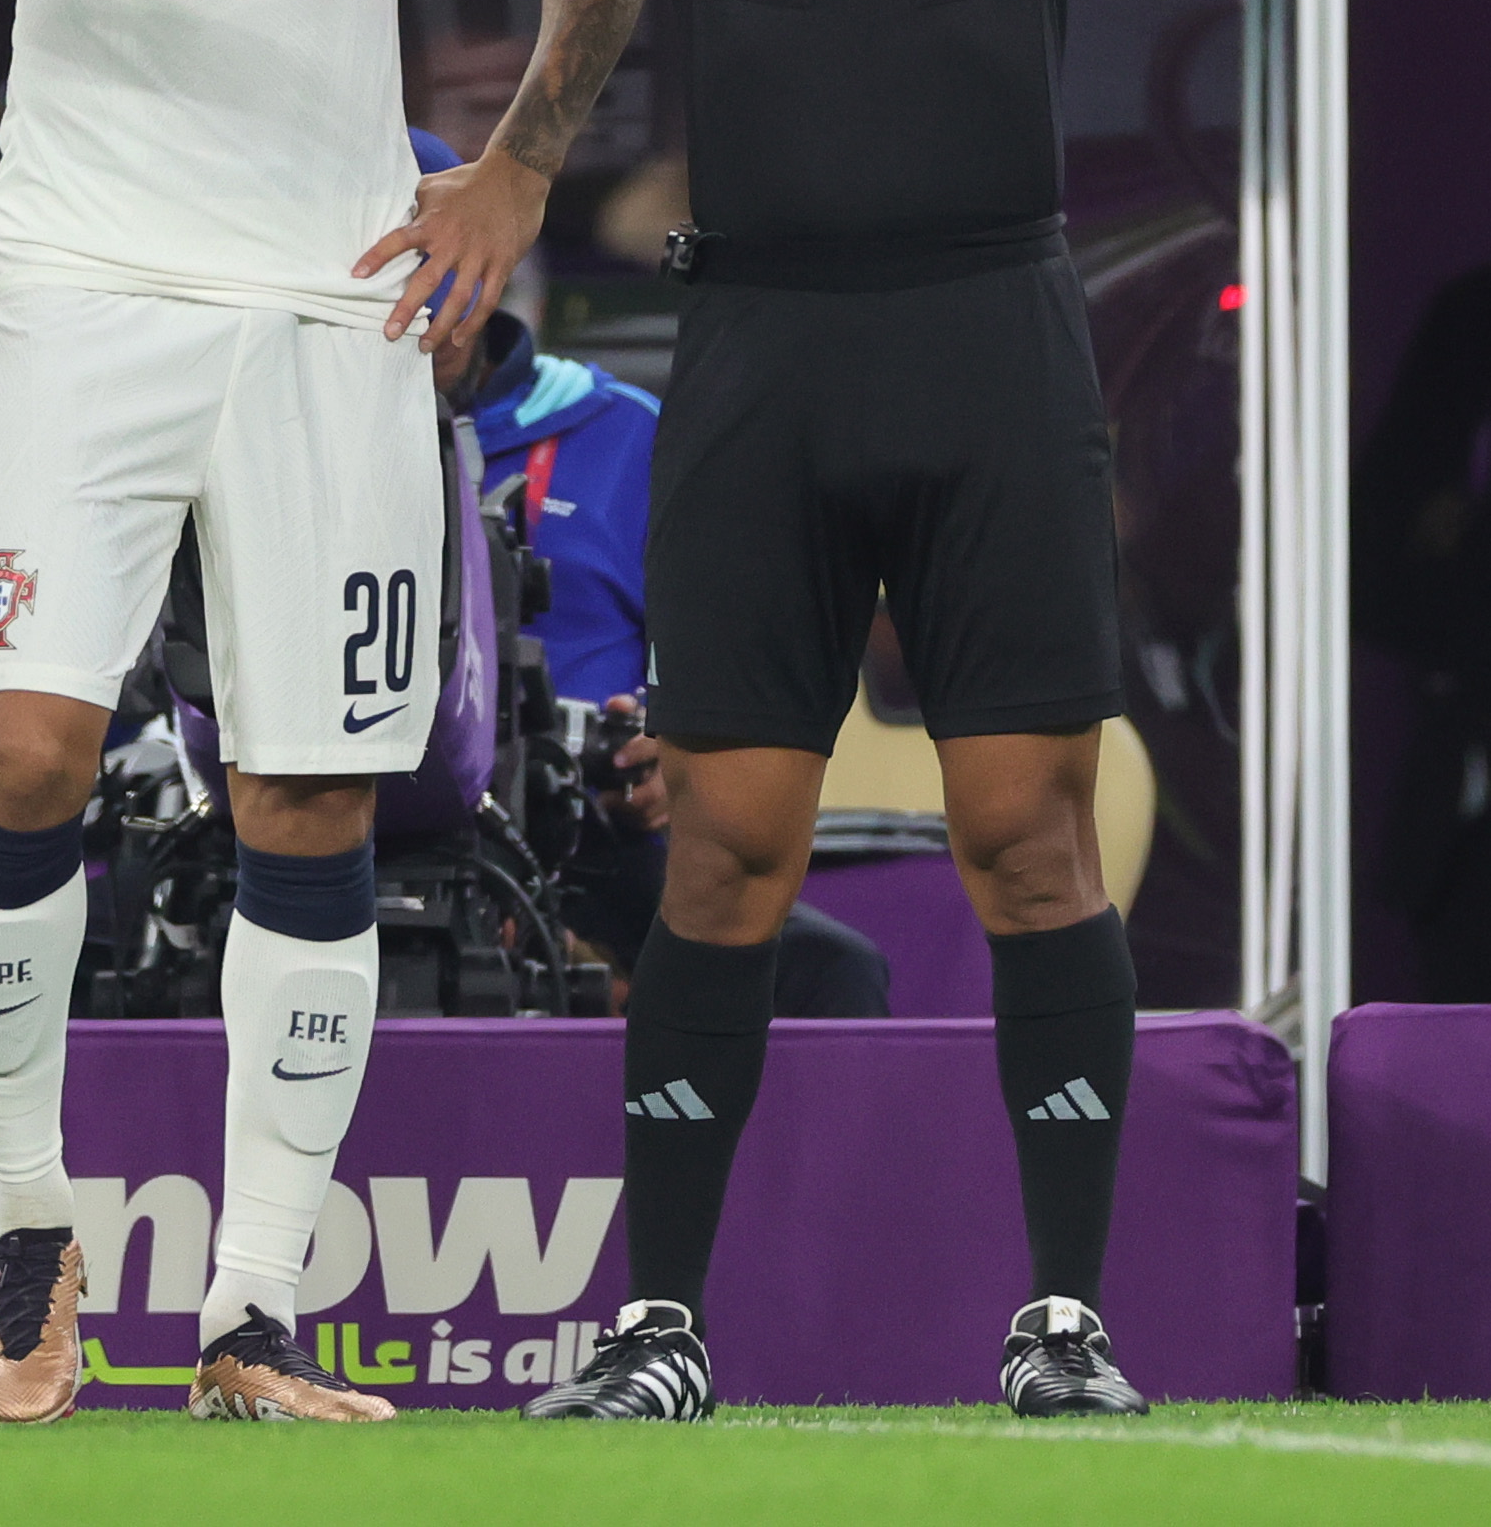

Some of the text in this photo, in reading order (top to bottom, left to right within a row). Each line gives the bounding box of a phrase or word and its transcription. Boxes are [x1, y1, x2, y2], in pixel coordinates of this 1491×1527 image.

[343, 569, 416, 695] 20
[428, 1320, 601, 1385] is all
